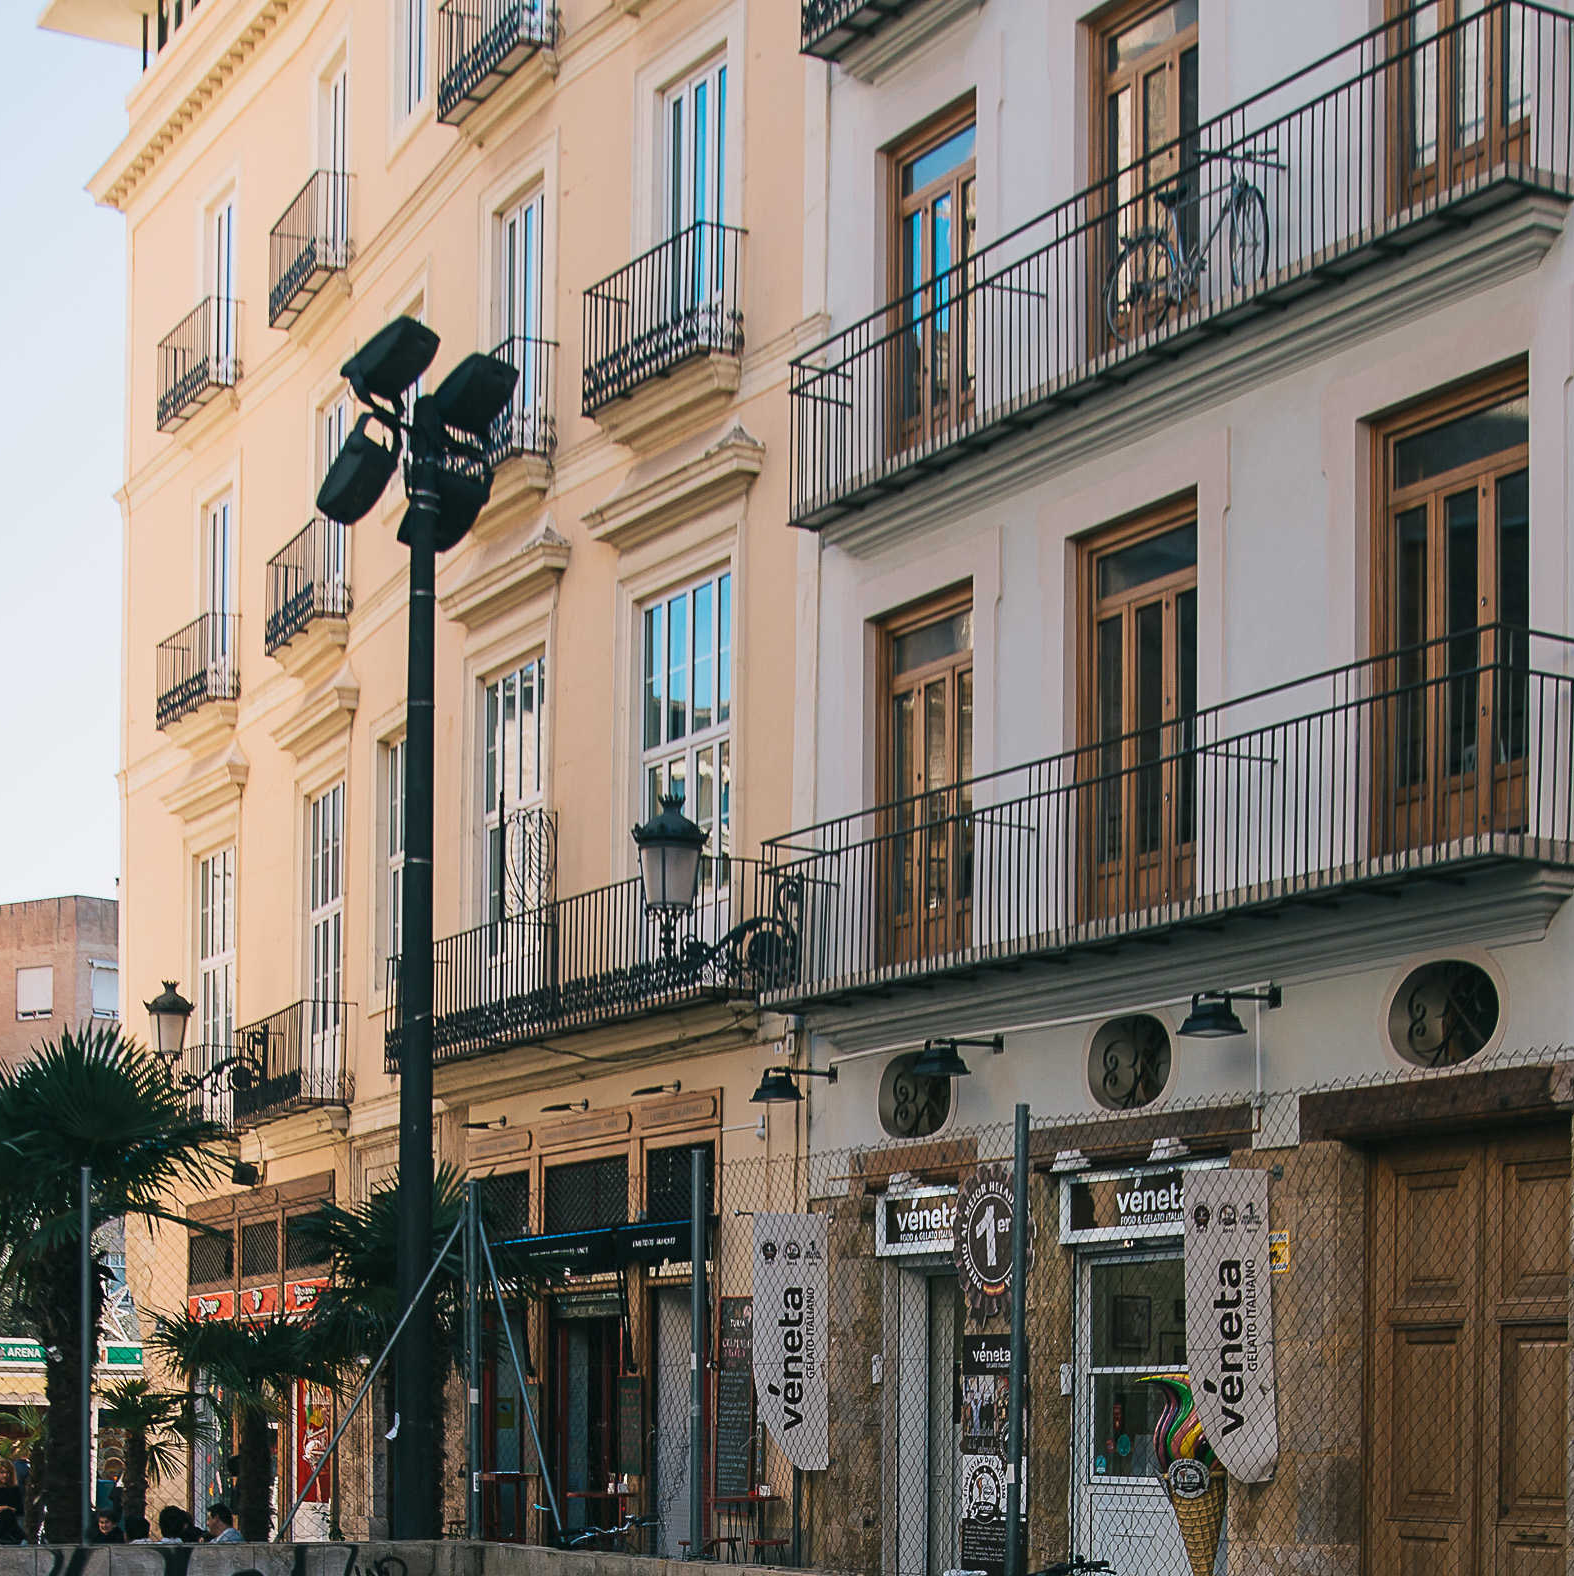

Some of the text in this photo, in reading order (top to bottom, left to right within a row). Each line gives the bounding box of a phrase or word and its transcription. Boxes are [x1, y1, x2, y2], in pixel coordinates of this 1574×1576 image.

[1120, 1213, 1137, 1226] FOOD
[1142, 1210, 1165, 1224] GELATO
[7, 1346, 42, 1359] ARENA
[767, 1285, 804, 1432] véneta
[806, 1287, 815, 1379] GELATO ITALIANO
[972, 1341, 1012, 1363] véneta
[1203, 1258, 1245, 1438] véneta
[1245, 1259, 1258, 1372] GELATO ITALIANO
